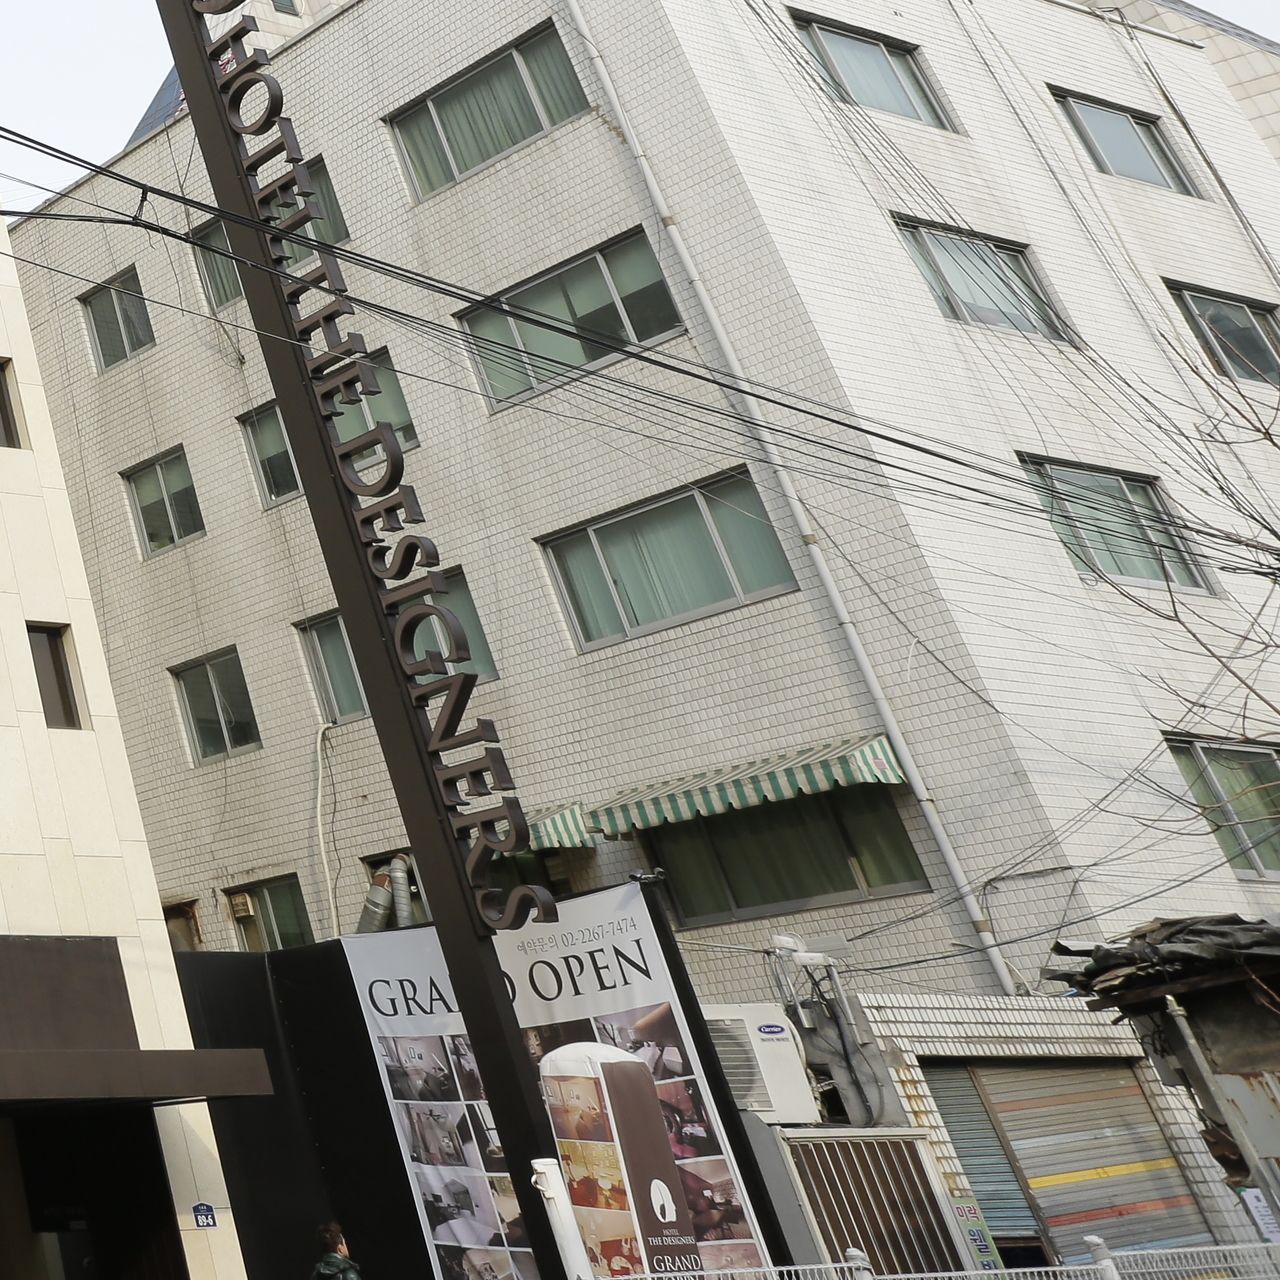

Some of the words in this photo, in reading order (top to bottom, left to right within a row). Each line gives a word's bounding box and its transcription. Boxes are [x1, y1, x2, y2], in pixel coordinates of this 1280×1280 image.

[206, 15, 325, 264] HOTEL
[285, 251, 383, 418] THE
[333, 421, 560, 931] DESIGNERS
[517, 934, 560, 956] 예약문의
[561, 916, 638, 948] 02-2267-7474
[528, 937, 653, 1002] OPEN
[955, 1204, 981, 1223] 미락
[647, 1236, 663, 1246] THE
[662, 1235, 696, 1246] DESIGNERS
[653, 1254, 701, 1271] GRAND
